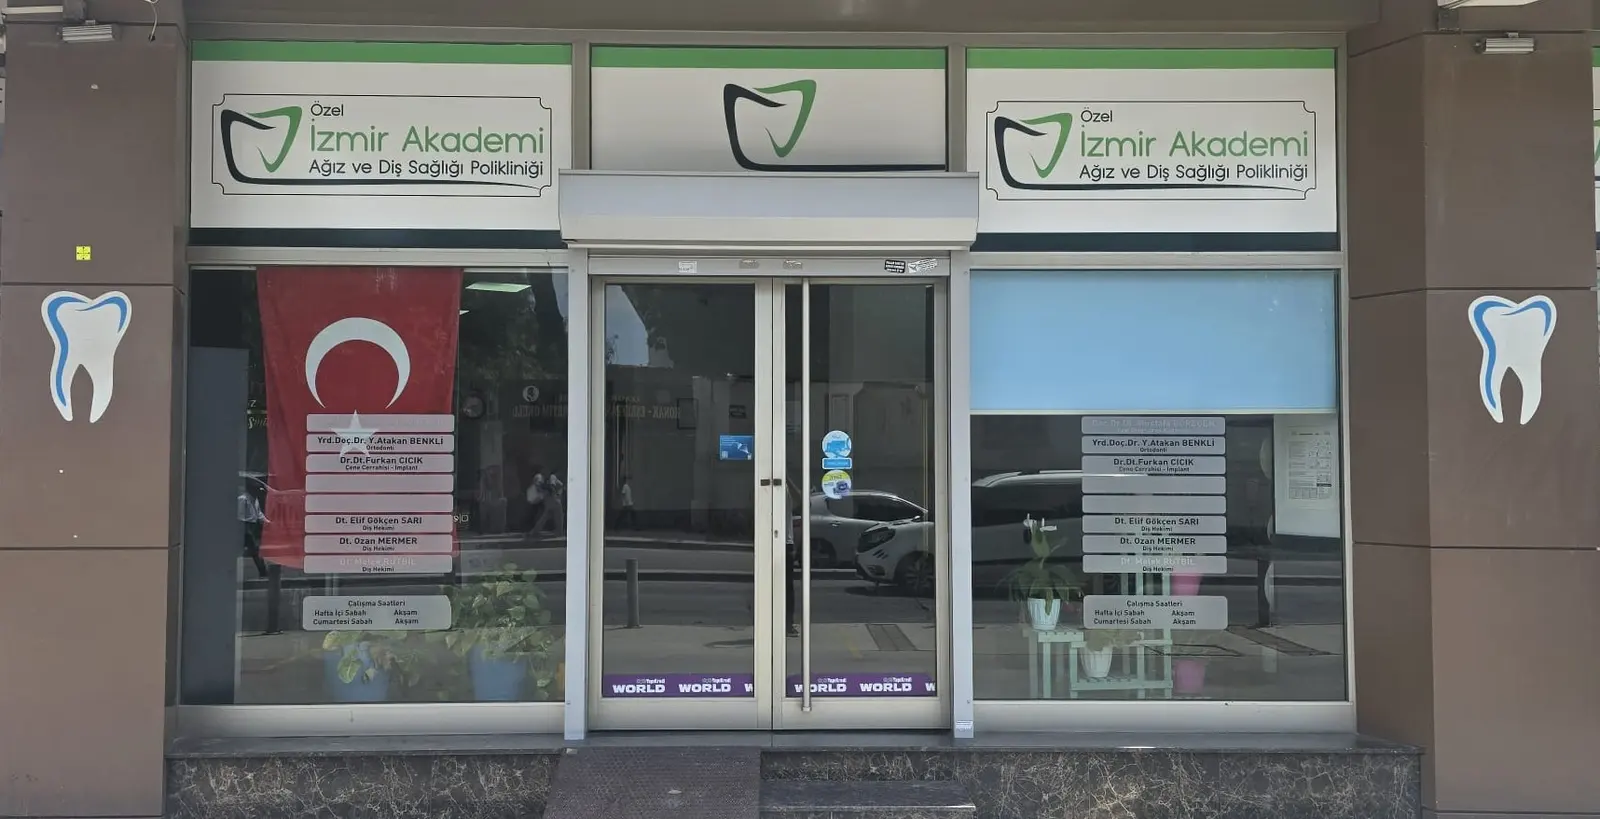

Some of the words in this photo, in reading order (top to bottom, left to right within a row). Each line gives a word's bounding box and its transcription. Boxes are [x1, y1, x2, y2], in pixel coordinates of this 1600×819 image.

[311, 101, 343, 117] Özel
[1081, 107, 1112, 123] Özel
[310, 118, 389, 152] İzmir
[402, 125, 544, 154] Akademi
[1081, 125, 1156, 157] İzmir
[1169, 131, 1308, 157] Akademi
[309, 158, 345, 176] Ağız
[352, 162, 372, 174] ve
[379, 159, 402, 176] Diş
[409, 160, 463, 177] Sağlığı
[471, 160, 543, 179] Polikliniği
[1080, 164, 1114, 181] Ağız
[1121, 168, 1140, 179] ve
[1147, 165, 1169, 181] Diş
[1176, 164, 1230, 182] Sağlığı
[1237, 165, 1308, 182] Polikliniği
[369, 437, 407, 445] Y.Atakan
[410, 437, 443, 445] BENKLİ
[1092, 439, 1139, 447] Yrd.Doç.Dr.
[1142, 439, 1179, 447] Y.Atakan
[1182, 439, 1214, 447] BENKLİ
[340, 456, 396, 464] Dr.Dt.Furkan
[1114, 458, 1168, 466] Dr.Dt.Furkan
[336, 516, 347, 524] Dt.
[350, 516, 365, 524] Elif
[368, 516, 398, 526] Gökçen
[402, 516, 422, 524] SARI
[1115, 517, 1126, 525] Dt.
[1129, 517, 1143, 525] Elif
[1146, 517, 1176, 526] Gökçen
[340, 537, 352, 545] Dt.
[354, 537, 375, 545] Ozan
[378, 537, 417, 545] MERMER
[1120, 537, 1132, 545] Dt.
[1134, 537, 1155, 545] Ozan
[1157, 537, 1196, 545] MERMER
[315, 609, 333, 617] Hafta
[345, 609, 366, 617] Sabah
[394, 609, 417, 617] Akşam
[395, 618, 418, 626] Akşam
[1173, 618, 1196, 626] Akşam
[613, 684, 665, 693] WORLD
[678, 683, 731, 693] WORLD
[859, 682, 912, 692] WORLD
